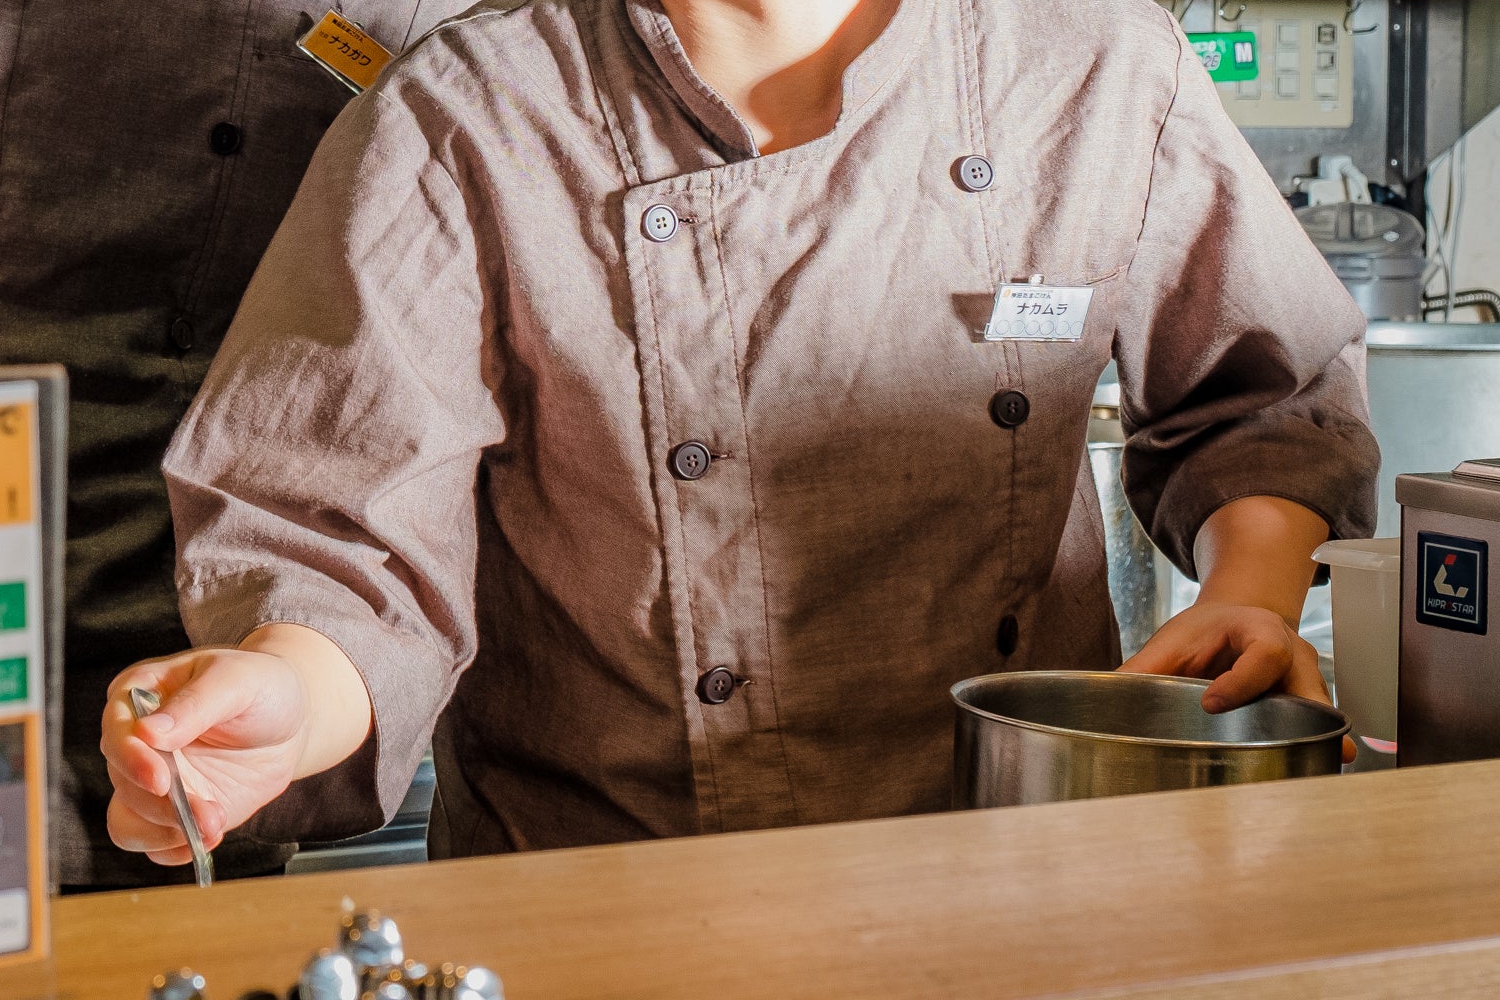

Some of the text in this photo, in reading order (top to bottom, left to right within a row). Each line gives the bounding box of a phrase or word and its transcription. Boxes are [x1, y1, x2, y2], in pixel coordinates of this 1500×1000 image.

[328, 35, 373, 66] ナカガワ
[1017, 302, 1068, 315] ナカムラ
